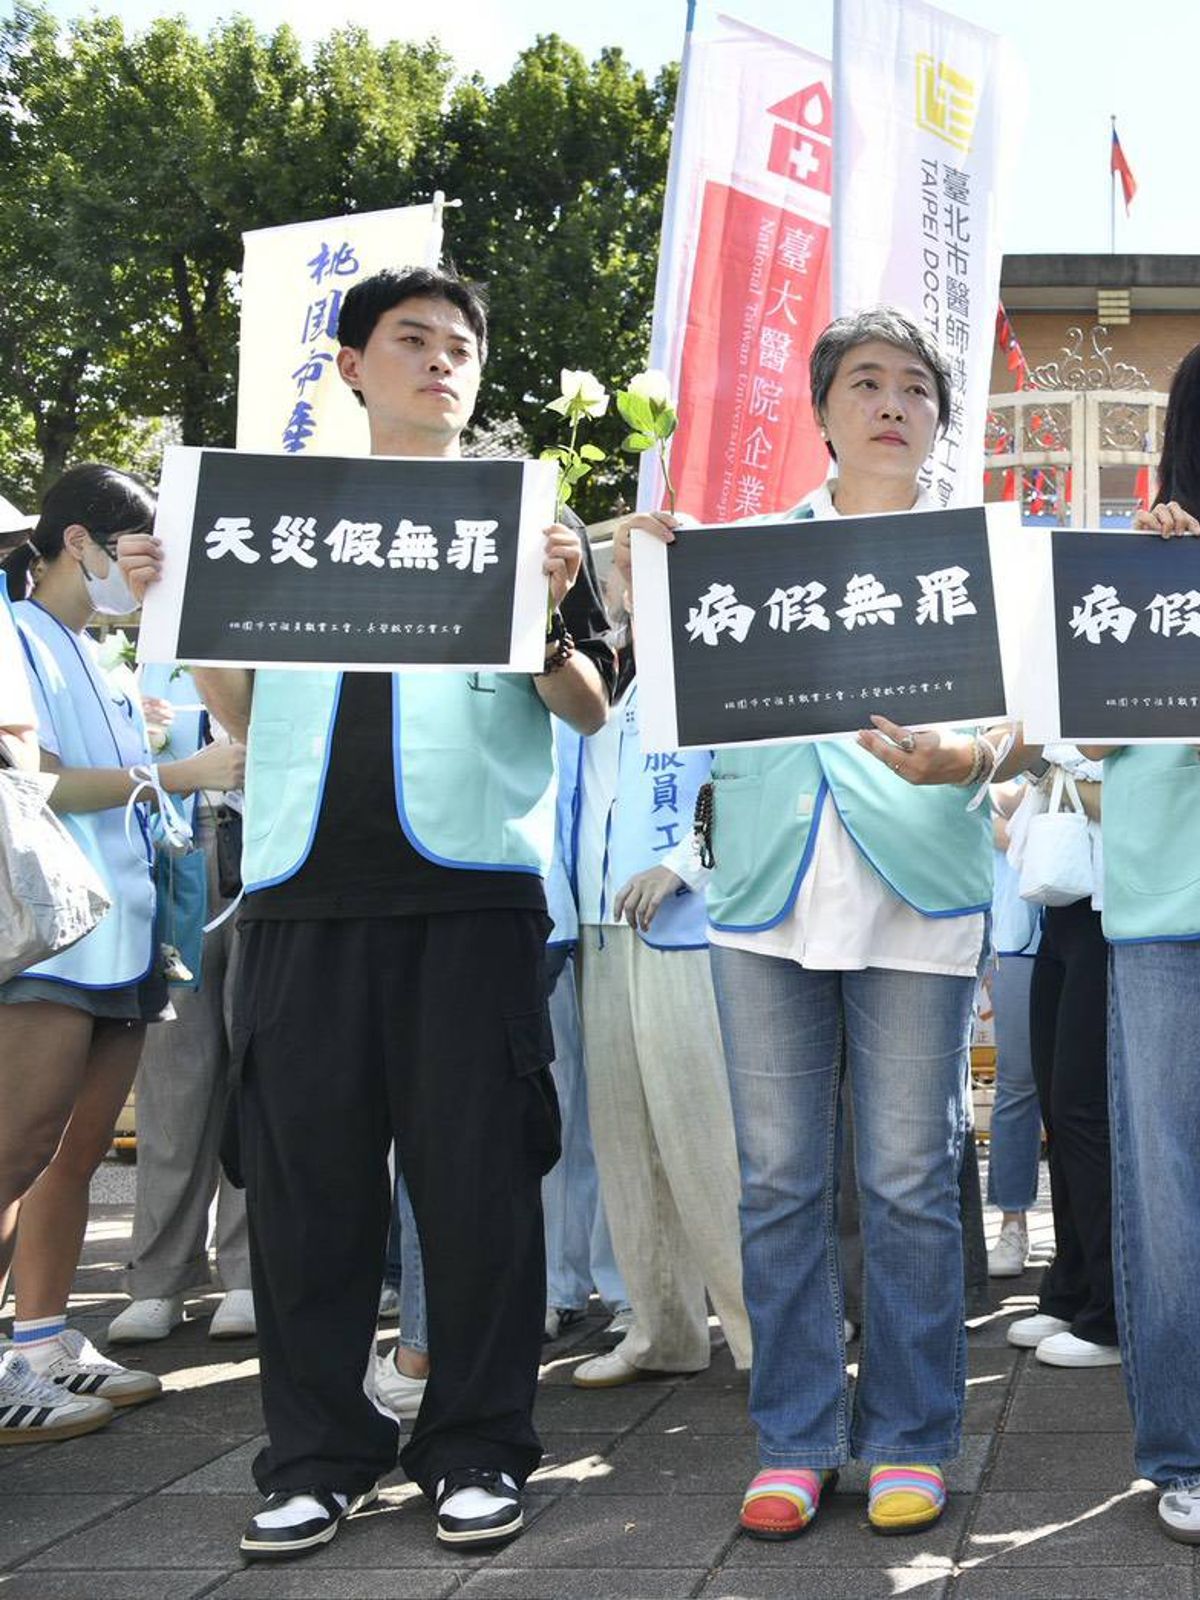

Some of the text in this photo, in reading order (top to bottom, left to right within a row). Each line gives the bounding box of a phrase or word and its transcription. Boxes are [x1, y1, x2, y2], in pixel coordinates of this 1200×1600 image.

[747, 216, 775, 294] National
[919, 158, 940, 340] TAIPEI DOCT
[734, 225, 815, 516] 臺大醫院企業
[737, 301, 760, 366] Taiwan
[205, 516, 499, 574] 天災假無罪
[686, 565, 978, 646] 病假無罪
